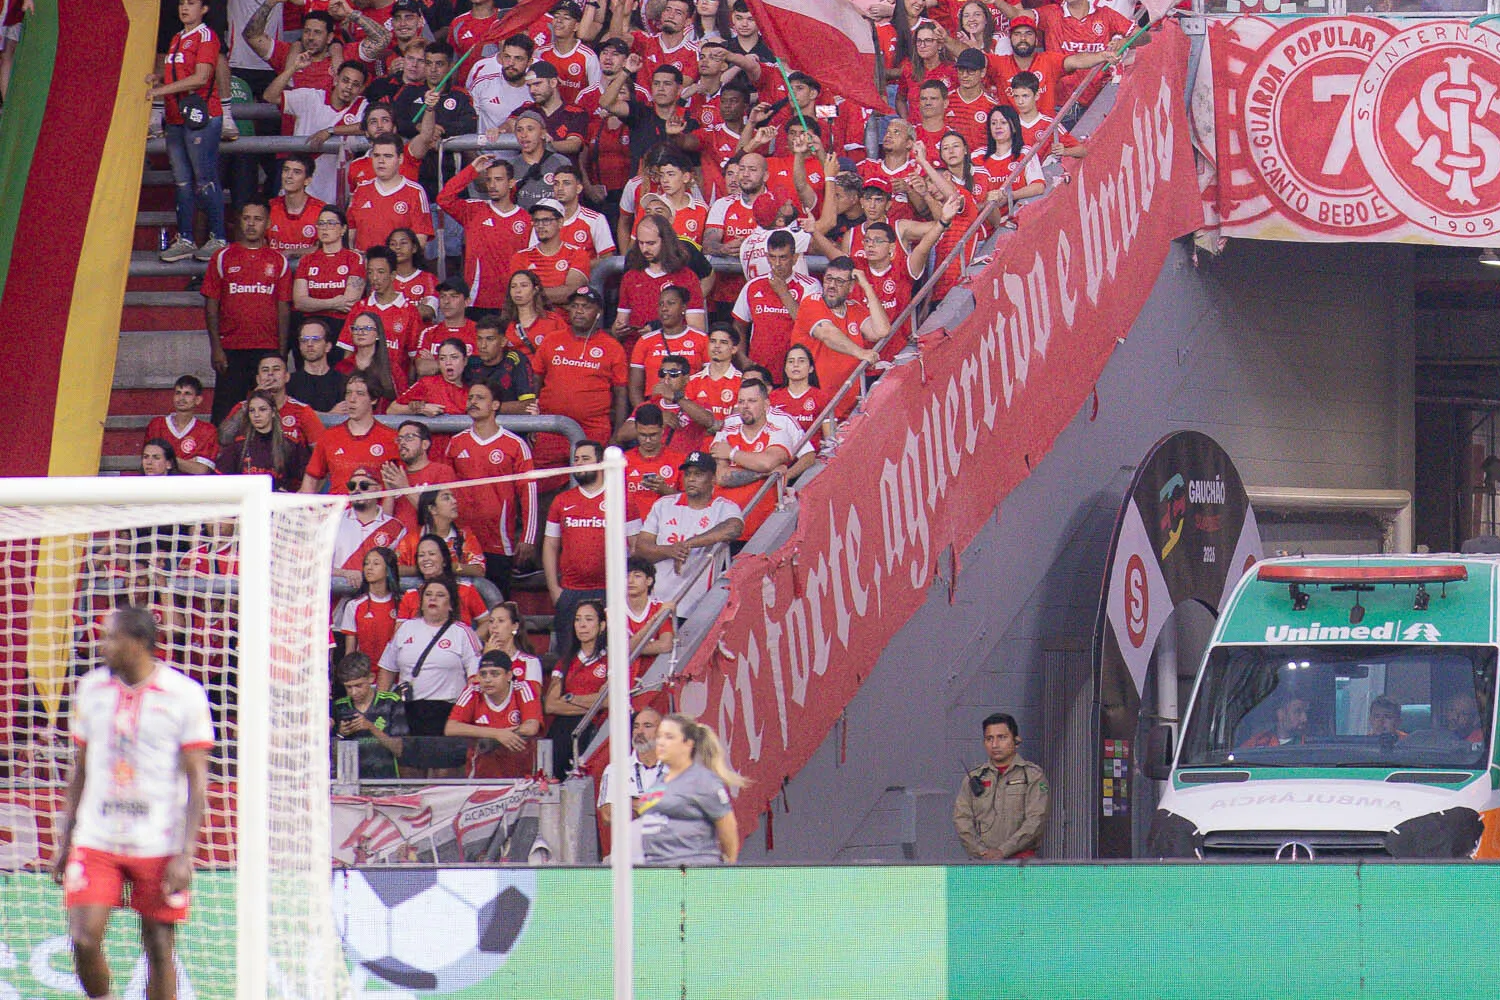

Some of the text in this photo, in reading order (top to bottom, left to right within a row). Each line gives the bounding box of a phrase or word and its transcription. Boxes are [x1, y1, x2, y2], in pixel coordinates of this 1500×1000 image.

[1249, 25, 1377, 150] GUARDA POPULAR
[1311, 73, 1364, 176] 7
[1260, 153, 1310, 214] CANTO
[1317, 200, 1370, 226] BEBO
[1428, 215, 1496, 234] 1909
[308, 267, 319, 277] 10
[229, 282, 275, 295] Banrisul
[308, 279, 346, 291] Banrisul
[562, 358, 601, 370] banrisul
[1188, 474, 1226, 505] GAUCHÃO
[563, 517, 606, 529] Banrisu
[1264, 620, 1394, 643] Unimed
